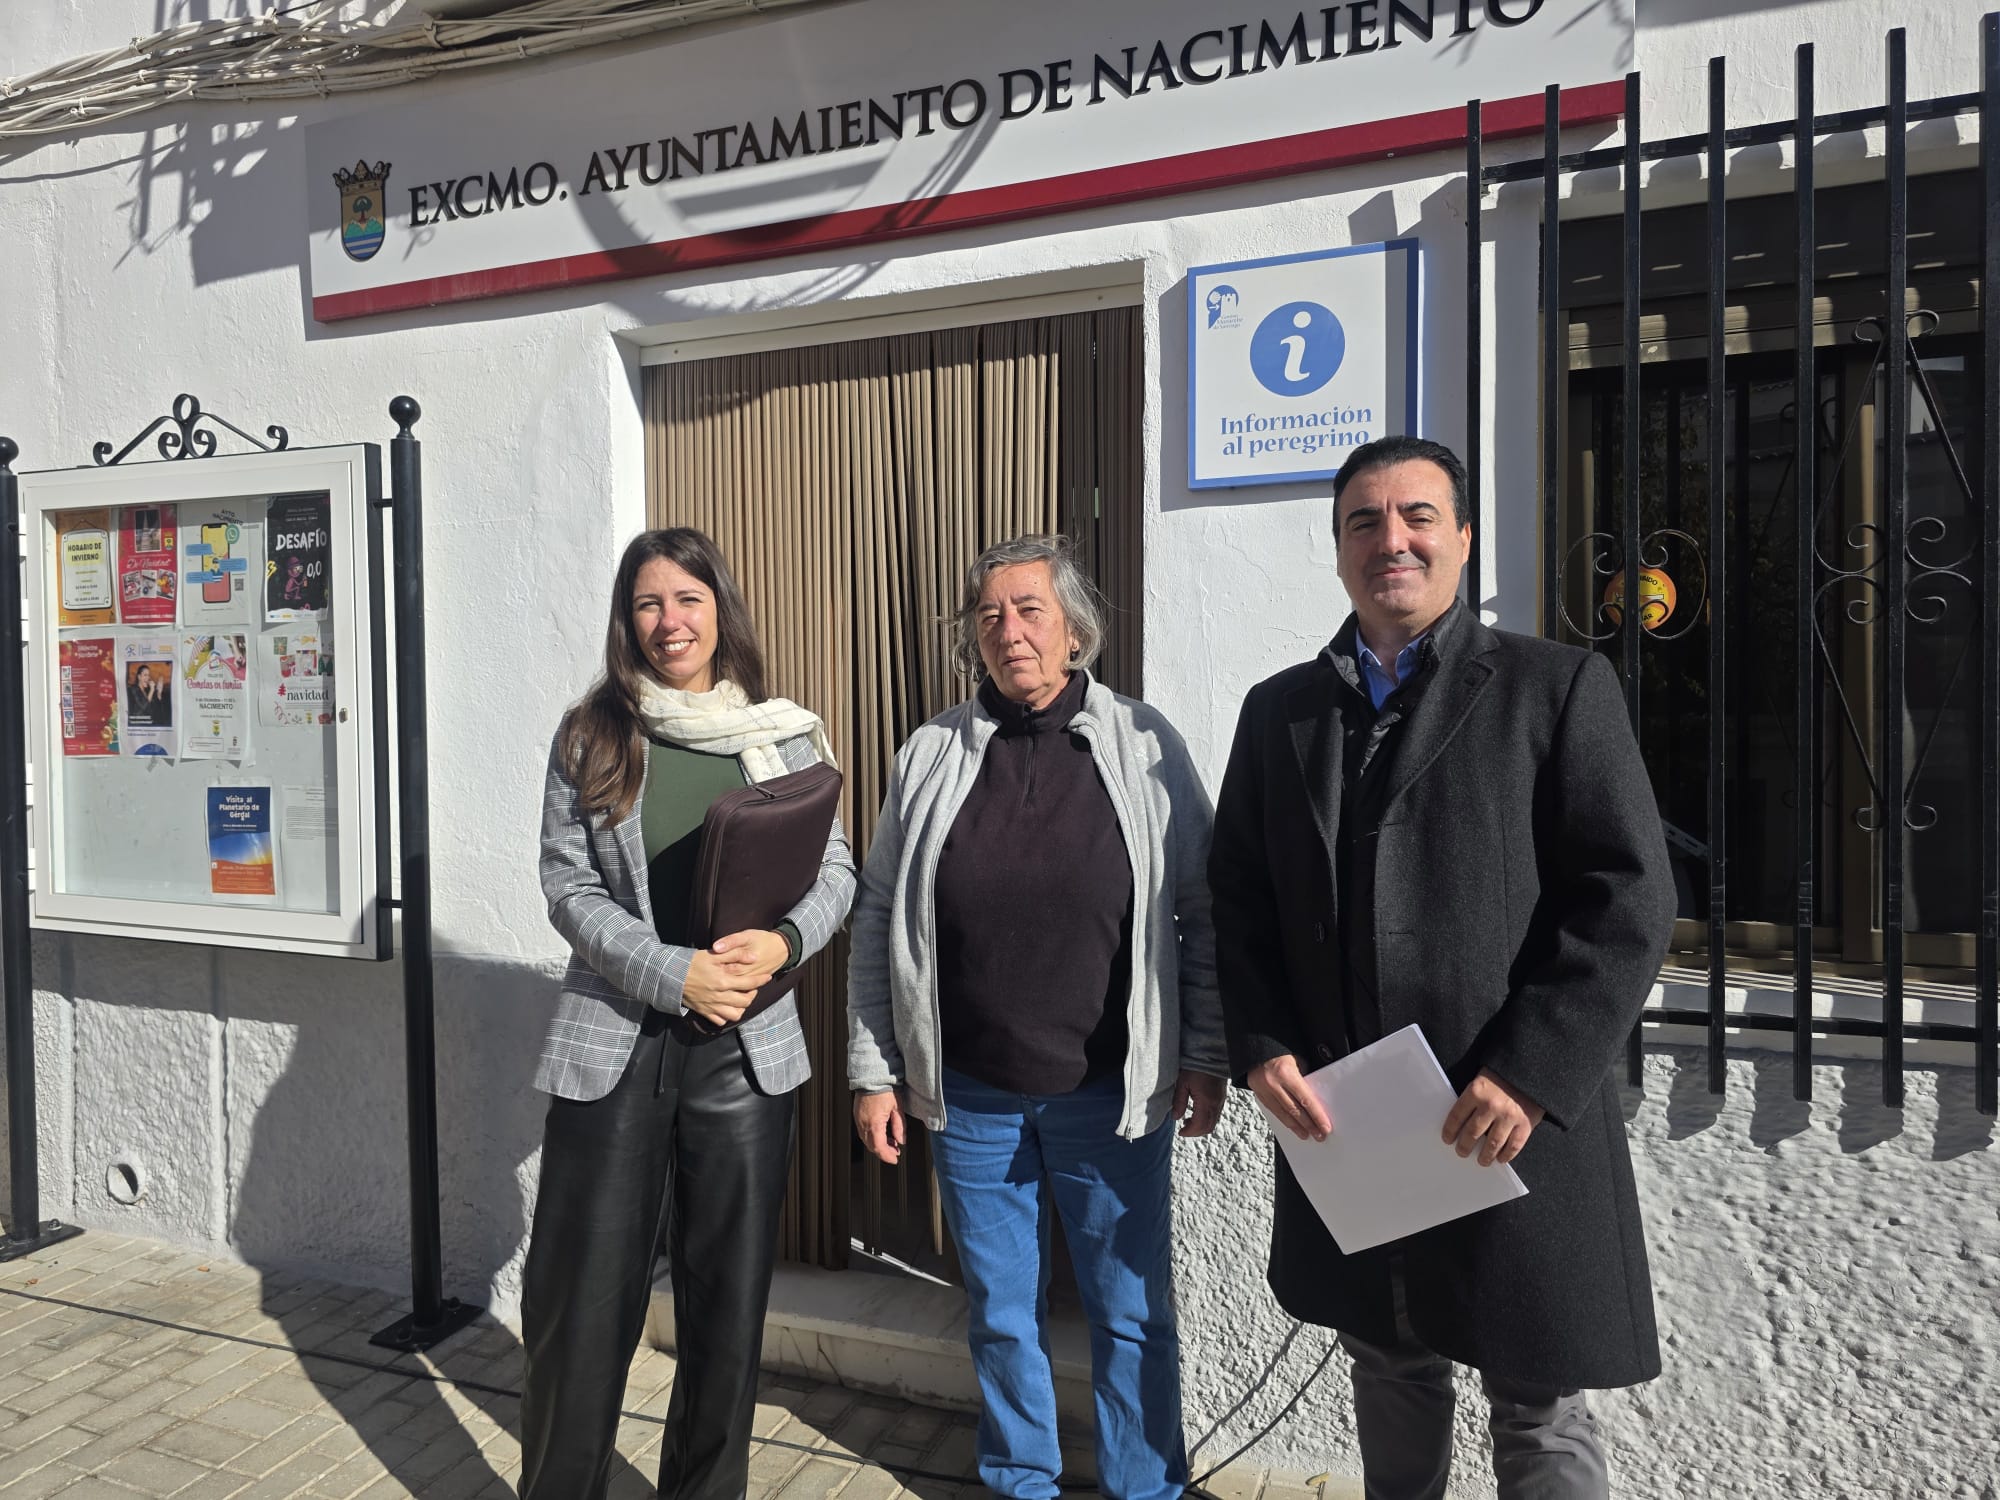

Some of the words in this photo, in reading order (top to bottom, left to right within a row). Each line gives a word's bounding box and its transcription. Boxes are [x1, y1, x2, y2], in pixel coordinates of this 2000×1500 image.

[408, 162, 568, 228] EXCMO.
[578, 78, 987, 196] AYUNTAMIENTO
[997, 58, 1073, 121] DE
[1221, 405, 1373, 435] Información
[1222, 436, 1243, 456] al
[1248, 429, 1370, 458] peregrino
[275, 528, 327, 551] DESAFÍO
[67, 543, 93, 552] HORARIO
[94, 542, 102, 550] DE
[71, 553, 99, 562] INVIERNO
[287, 689, 329, 701] navidad
[225, 794, 244, 804] Visita
[218, 802, 250, 811] Planetario
